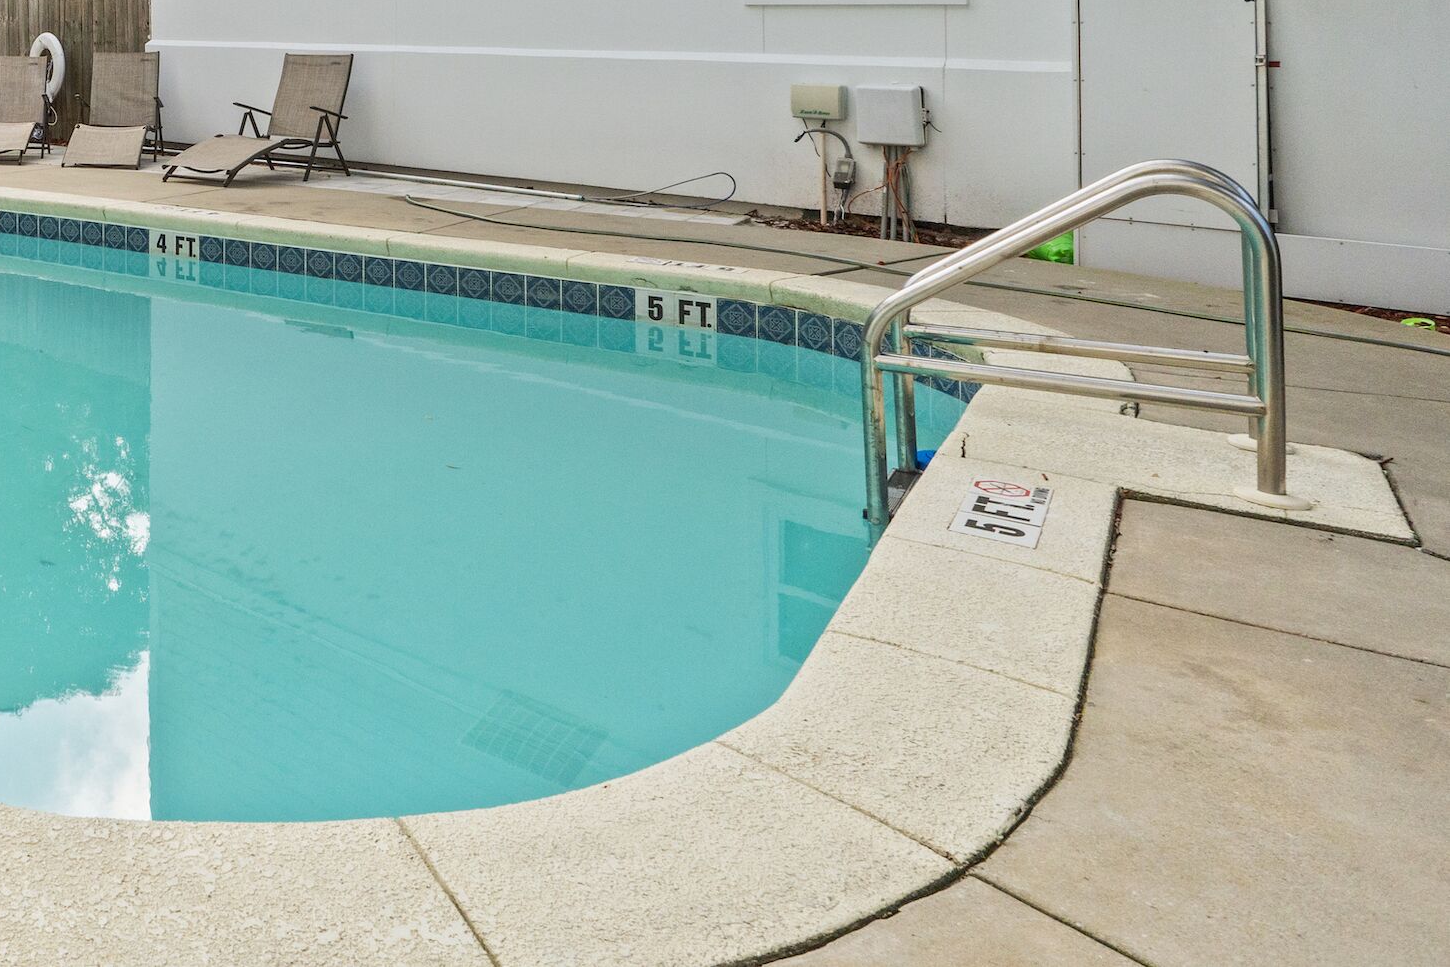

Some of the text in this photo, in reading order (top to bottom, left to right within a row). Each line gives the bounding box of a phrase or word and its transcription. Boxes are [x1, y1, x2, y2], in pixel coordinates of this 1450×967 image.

[156, 233, 196, 258] 4 FT.
[648, 295, 712, 328] 5 FT.
[964, 495, 1035, 537] 5 FT.
